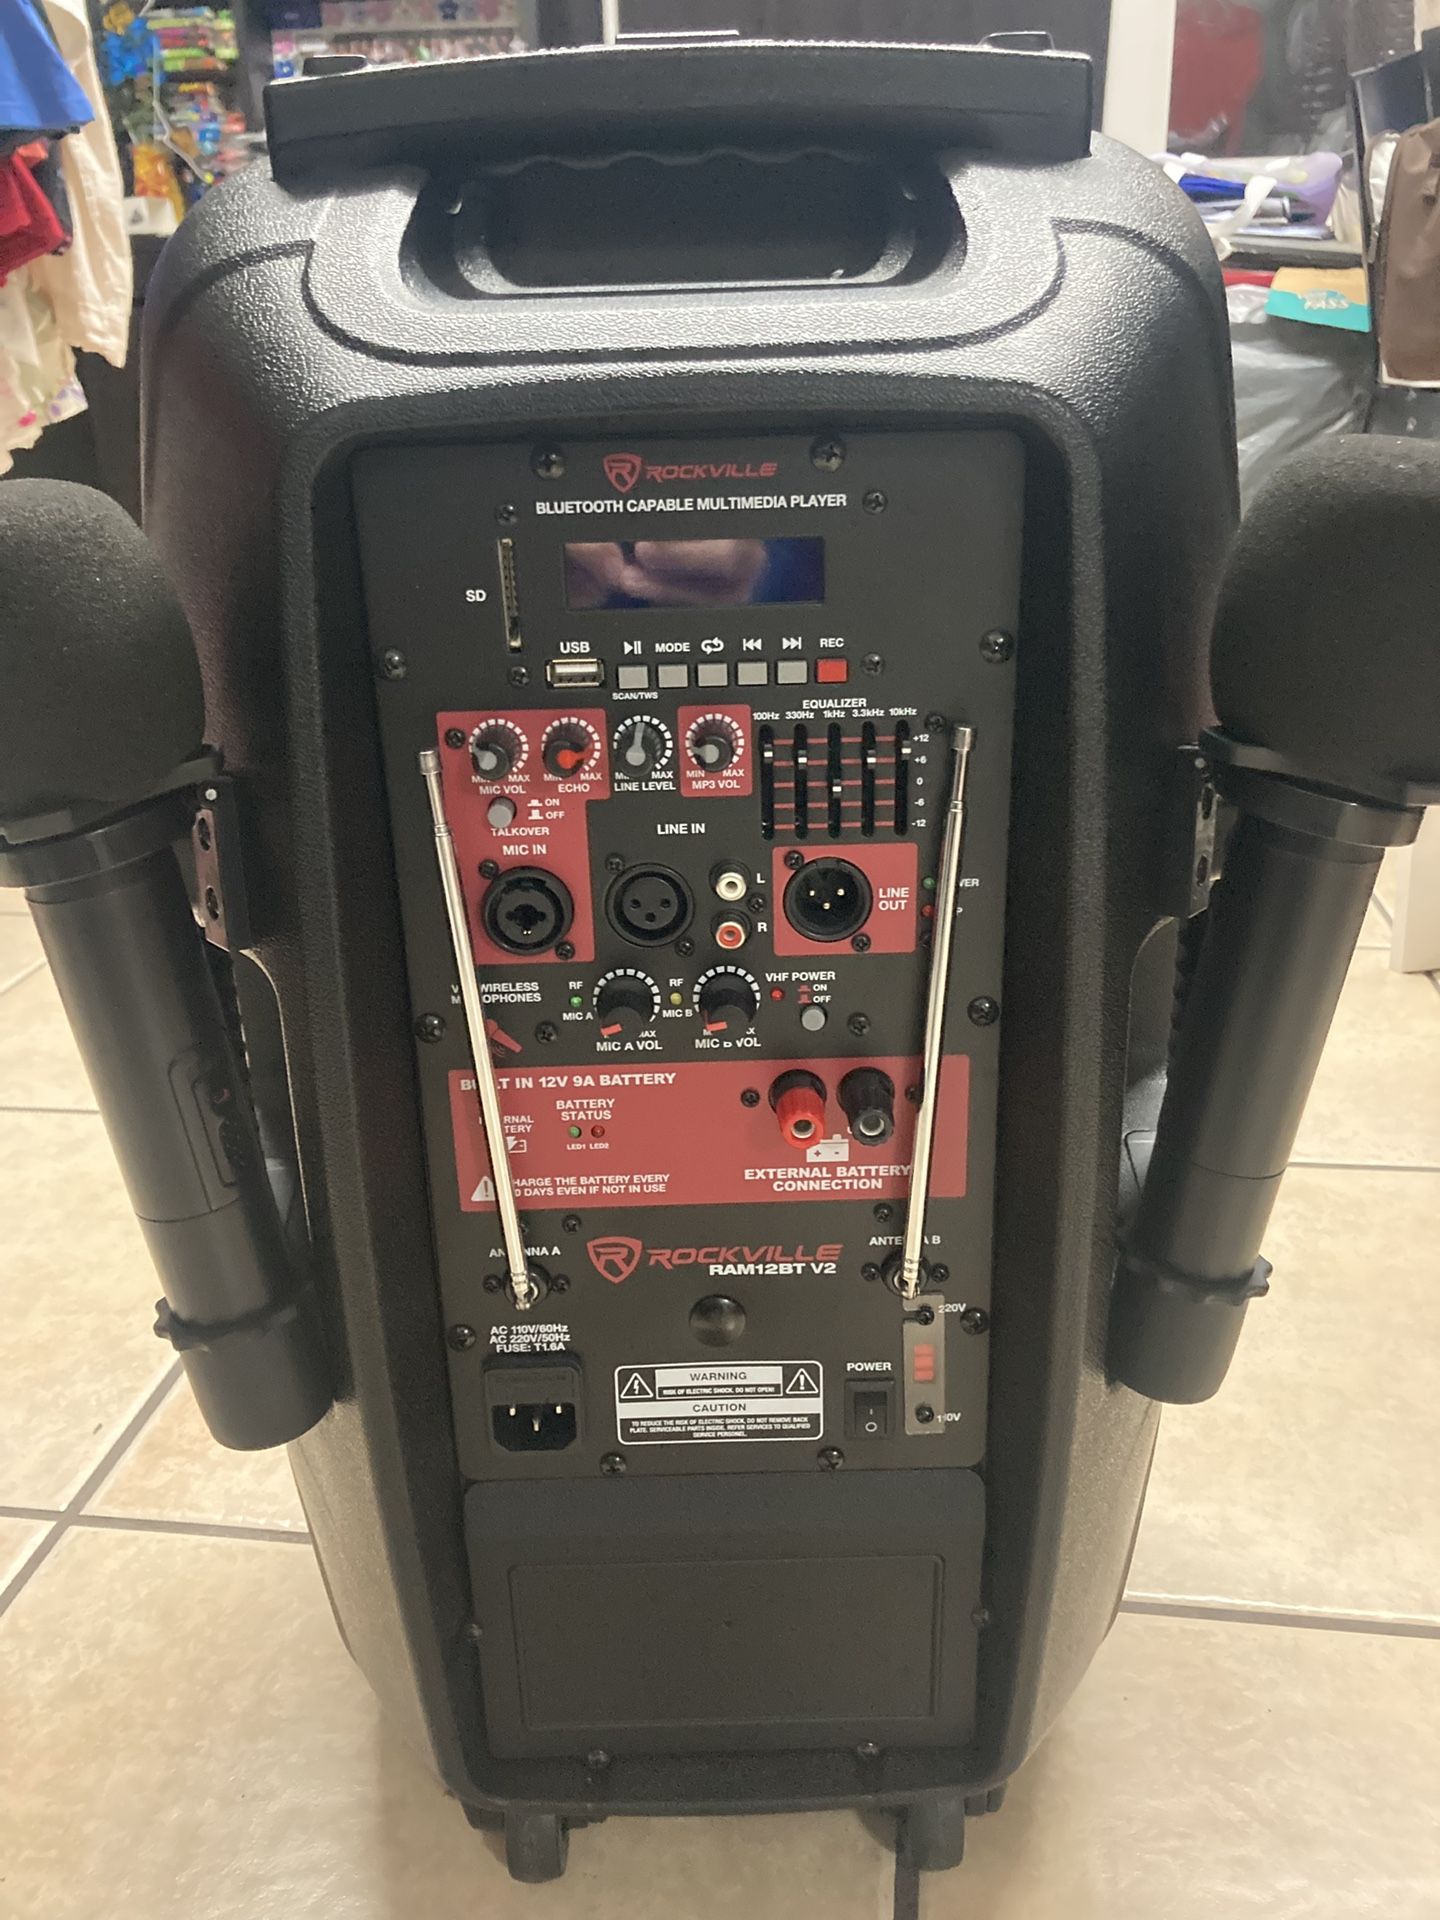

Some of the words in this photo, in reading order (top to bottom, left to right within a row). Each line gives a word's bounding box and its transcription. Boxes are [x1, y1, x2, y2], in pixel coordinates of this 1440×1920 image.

[645, 463, 778, 483] ROCKVILLE
[536, 500, 624, 515] BLUETOOTH
[626, 498, 694, 512] CAPABLE
[696, 495, 787, 511] MULTIMEDIA
[790, 494, 847, 508] PLAYER
[465, 590, 487, 602] SD
[560, 642, 591, 654] USB
[655, 642, 691, 653] MODE
[819, 638, 844, 648] REC
[612, 692, 658, 700] SCAN/TWS
[802, 698, 867, 709] EQUALIZER
[752, 712, 780, 720] 100Hz
[785, 711, 815, 720] 330Hz
[823, 709, 846, 718] 1kHz
[852, 708, 885, 718] 3.3kHz
[889, 707, 917, 717] 10kHz
[913, 734, 929, 742] +12
[914, 756, 927, 764] +6
[508, 774, 531, 783] MAX
[580, 772, 602, 781] MAX
[651, 771, 673, 780] MAX
[686, 770, 705, 778] MIN
[723, 769, 745, 778] MAX
[614, 782, 640, 792] LINE
[642, 781, 676, 791] LEVEL
[692, 780, 719, 790] MP3
[721, 779, 741, 789] VOL
[916, 777, 924, 786] 0
[479, 785, 501, 795] MIC
[503, 785, 526, 794] VOL
[558, 783, 590, 793] ECHO
[545, 798, 560, 806] ON
[914, 799, 925, 807] -6
[545, 811, 565, 819] OFF
[657, 824, 687, 835] LINE
[690, 823, 705, 834] IN
[911, 820, 927, 828] -12
[491, 826, 550, 837] TALKOVER
[502, 844, 529, 855] MIC
[532, 844, 546, 854] IN
[756, 873, 765, 883] L
[879, 888, 909, 899] LINE
[878, 900, 907, 911] OUT
[757, 923, 768, 933] R
[765, 972, 789, 982] VHF
[792, 971, 836, 981] POWER
[569, 981, 583, 990] RF
[669, 979, 684, 987] RF
[813, 984, 827, 992] ON
[451, 993, 542, 1004] MOPHONES
[813, 995, 831, 1003] OFF
[562, 1012, 583, 1021] MIC
[585, 1012, 594, 1020] A
[662, 1009, 683, 1018] MIC
[685, 1009, 693, 1017] B
[639, 1030, 656, 1038] AX
[596, 1041, 621, 1051] MIC
[624, 1041, 634, 1050] A
[636, 1040, 663, 1051] VOL
[695, 1038, 720, 1048] MIC
[736, 1037, 761, 1048] VOL
[515, 1077, 533, 1089] IN
[539, 1076, 568, 1087] 12V
[573, 1075, 595, 1087] 9A
[600, 1073, 676, 1086] BATTERY
[556, 1099, 615, 1110] BATTERY
[561, 1110, 611, 1120] STATUS
[567, 1143, 586, 1151] LED1
[744, 1167, 831, 1180] EXTERNAL
[836, 1165, 911, 1178] BATTERY
[513, 1177, 552, 1187] HARGE
[554, 1176, 577, 1185] THE
[580, 1175, 630, 1185] BATTERY
[633, 1174, 669, 1184] EVERY
[773, 1179, 883, 1192] CONNECTION
[524, 1187, 553, 1196] DAYS
[557, 1186, 586, 1195] EVEN
[589, 1186, 599, 1194] IF
[602, 1185, 626, 1194] NOT
[629, 1184, 640, 1193] IN
[643, 1183, 666, 1193] USE
[932, 1235, 941, 1245] B
[489, 1246, 549, 1258] ANNNA
[551, 1246, 561, 1256] A
[647, 1243, 844, 1270] ROCKVILLE
[709, 1263, 805, 1276] RAM12BT
[810, 1263, 837, 1274] V2
[938, 1303, 967, 1313] 220V
[490, 1326, 508, 1335] AC
[511, 1324, 569, 1334] 110V/60Hz
[490, 1335, 508, 1344] AC
[510, 1333, 571, 1344] 220V/50Hz
[496, 1344, 531, 1353] FUSE:
[534, 1343, 566, 1352] T1.6A
[847, 1362, 892, 1371] POWER
[690, 1372, 747, 1382] WARNING
[693, 1403, 747, 1413] CAUTION
